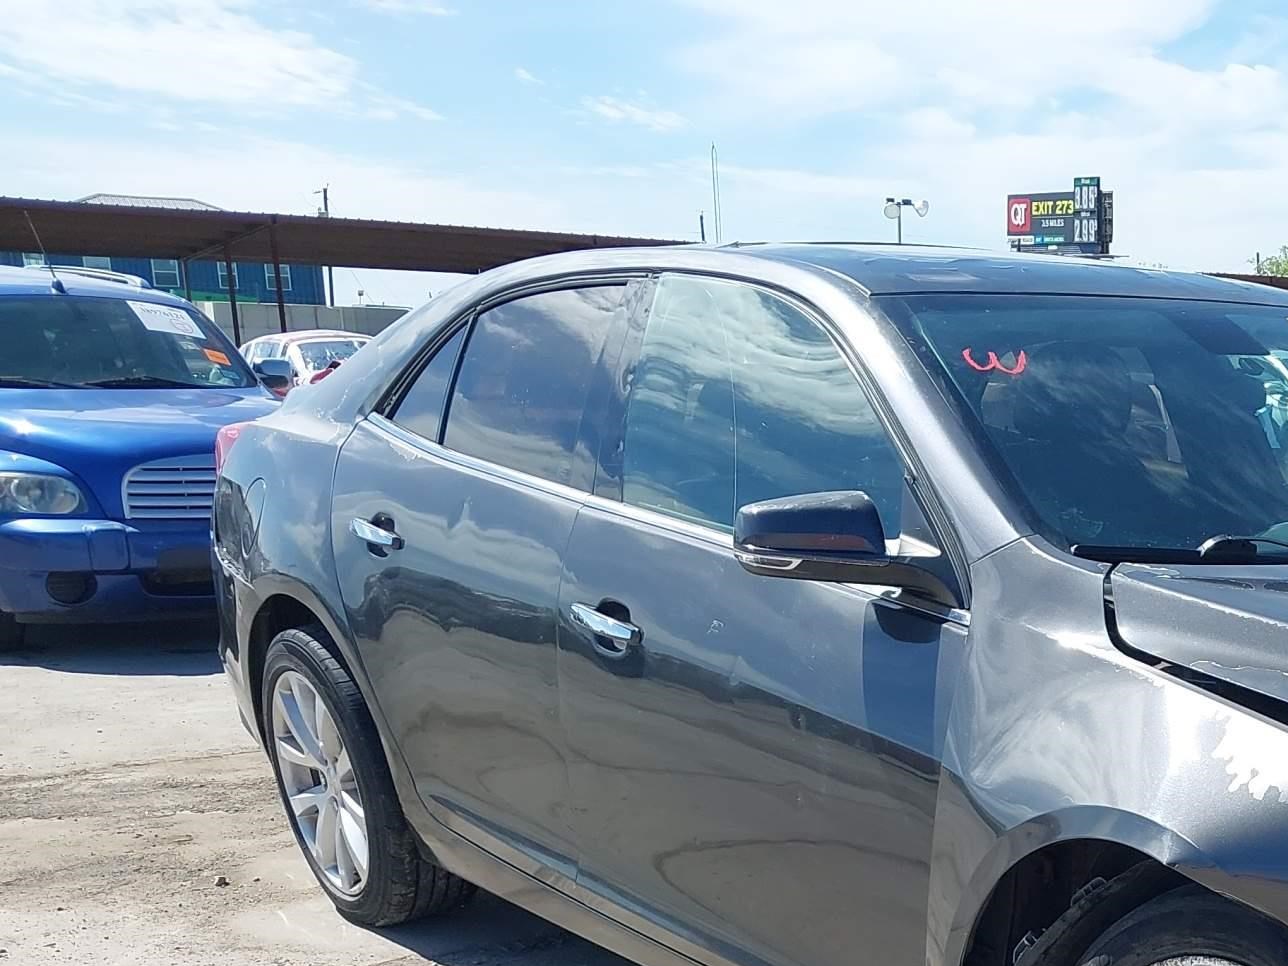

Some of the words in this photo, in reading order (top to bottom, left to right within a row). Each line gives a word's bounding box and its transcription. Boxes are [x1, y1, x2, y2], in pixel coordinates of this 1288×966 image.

[1011, 203, 1027, 227] QT
[1032, 201, 1053, 216] EXIT
[1055, 199, 1074, 214] 273
